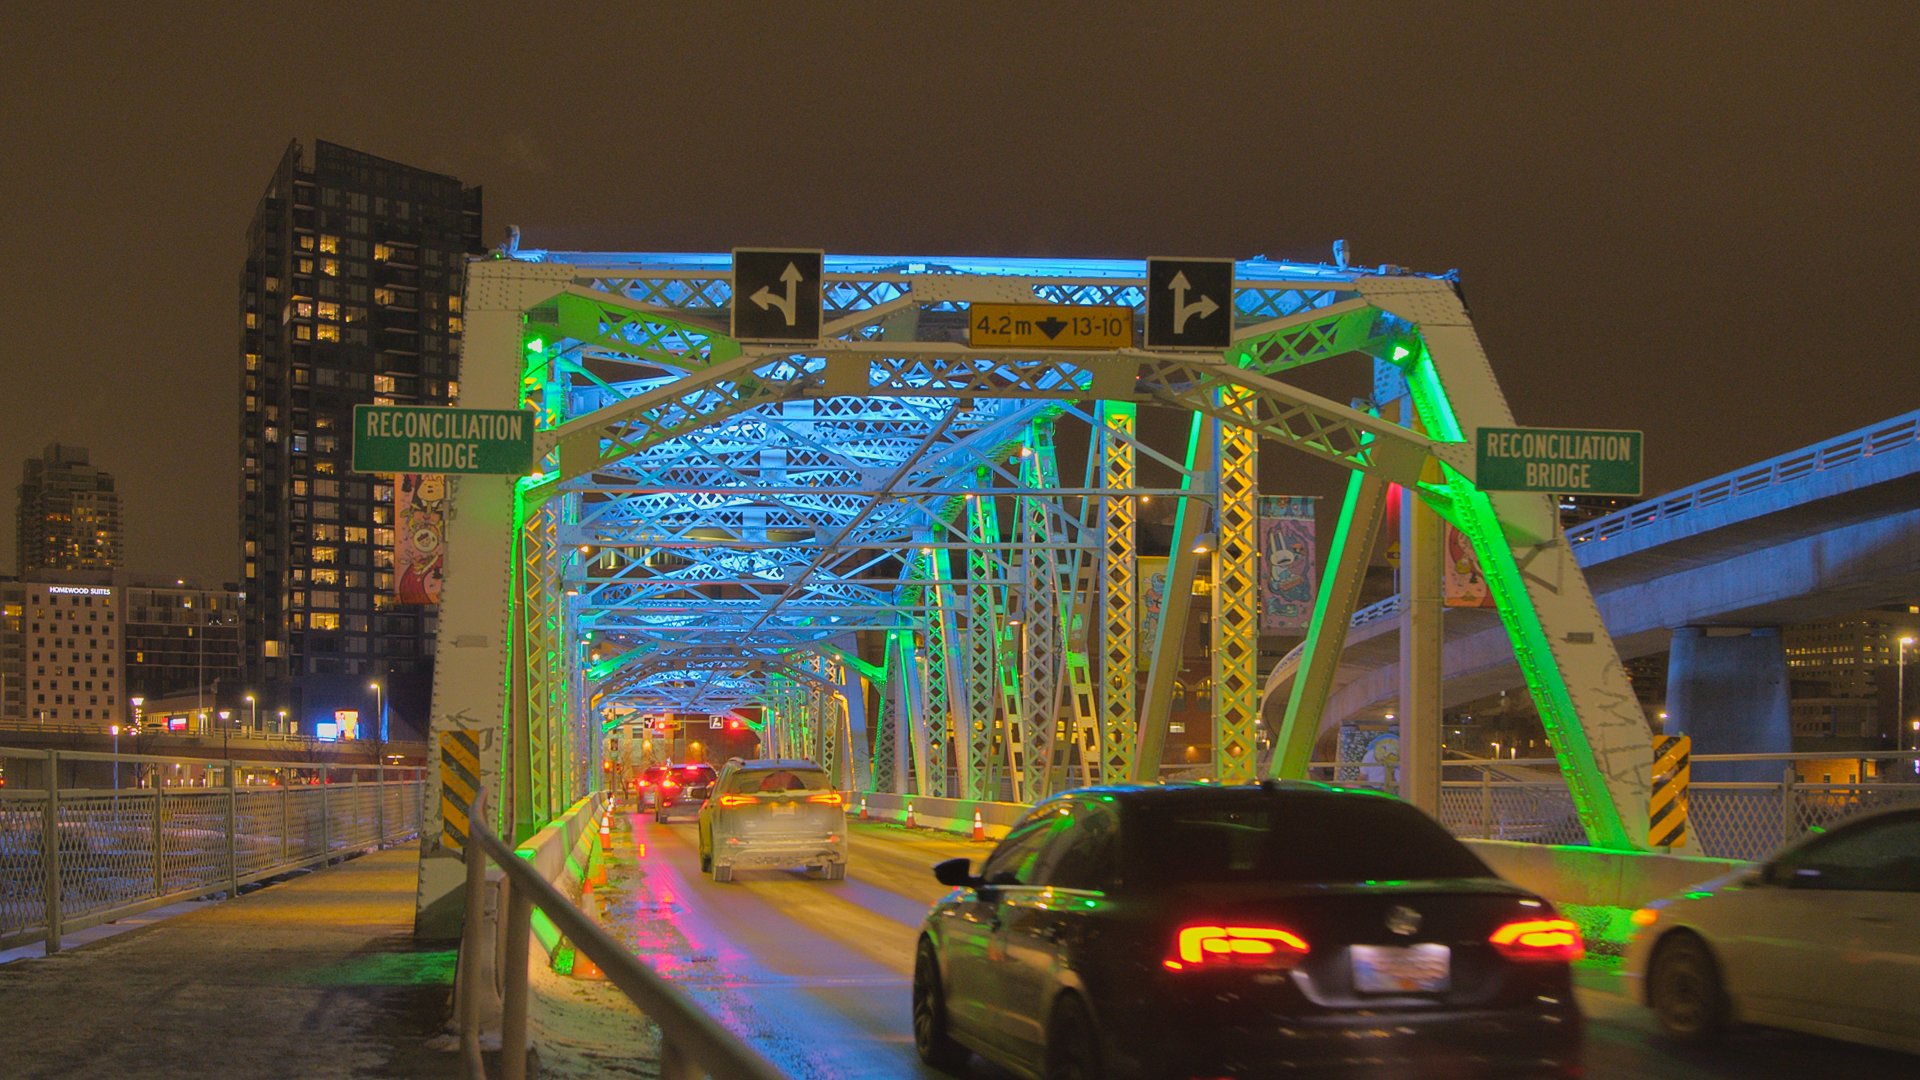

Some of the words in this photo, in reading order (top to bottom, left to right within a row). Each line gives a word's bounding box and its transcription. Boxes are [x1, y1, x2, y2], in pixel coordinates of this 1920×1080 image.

[366, 411, 523, 441] RECONCILIATION
[408, 442, 479, 470] BRIDGE
[1486, 432, 1632, 461] RECONCILIATION
[1525, 462, 1592, 489] BRIDGE
[49, 586, 89, 595] HOMEWOOD
[90, 587, 111, 596] SUITES
